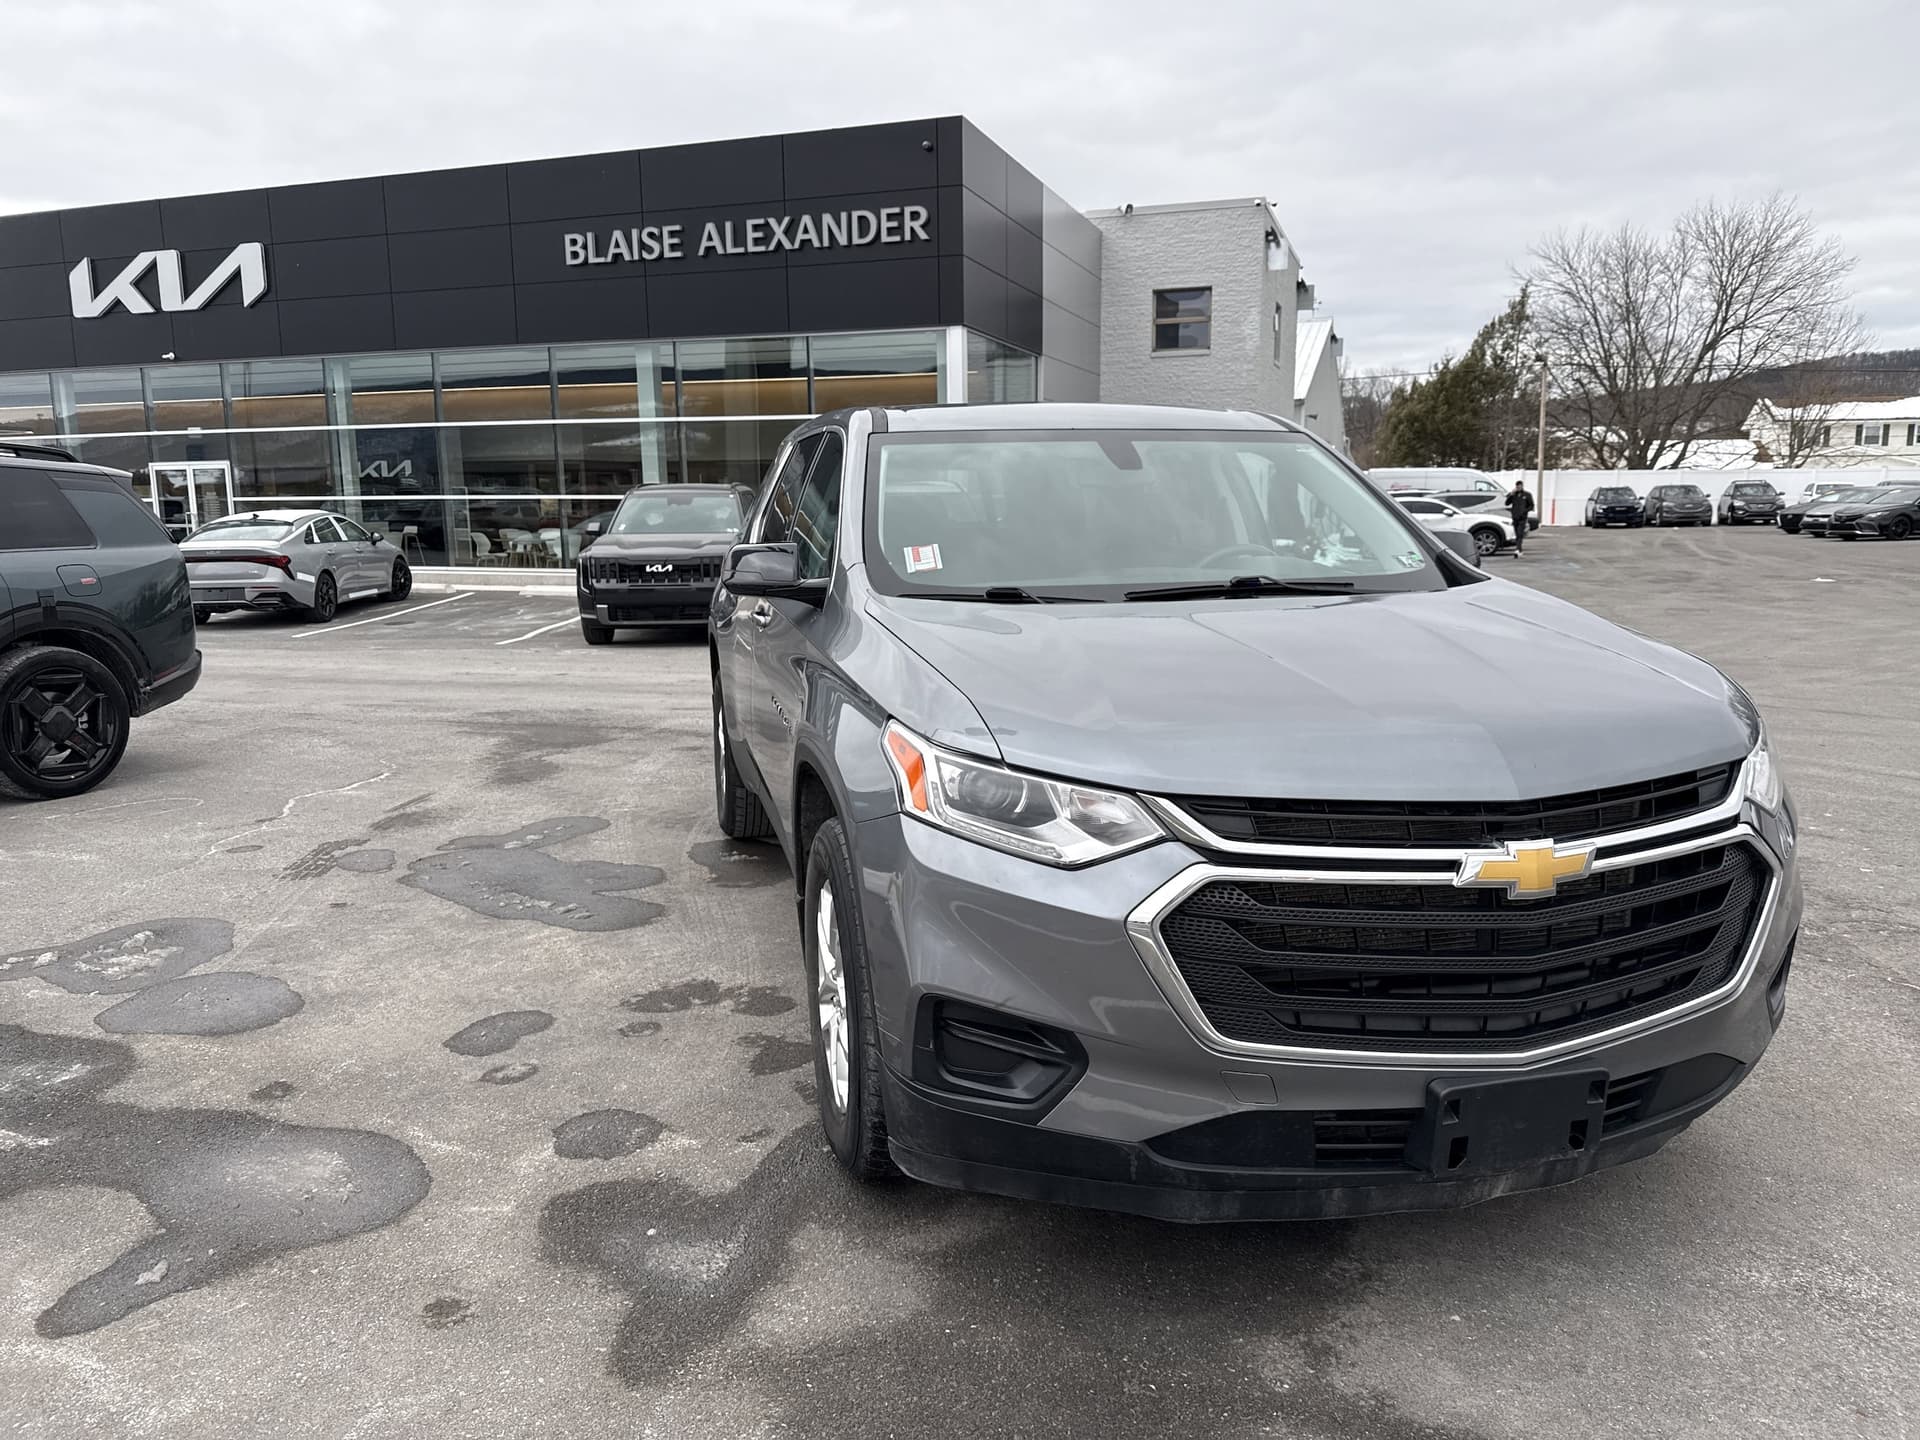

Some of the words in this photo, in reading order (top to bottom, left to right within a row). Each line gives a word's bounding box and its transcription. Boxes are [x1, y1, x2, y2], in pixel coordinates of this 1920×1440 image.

[564, 224, 683, 266] BLAISE
[697, 205, 930, 256] ALEXANDER
[69, 242, 267, 318] KIA
[358, 459, 412, 478] KIA
[645, 564, 673, 572] KIA
